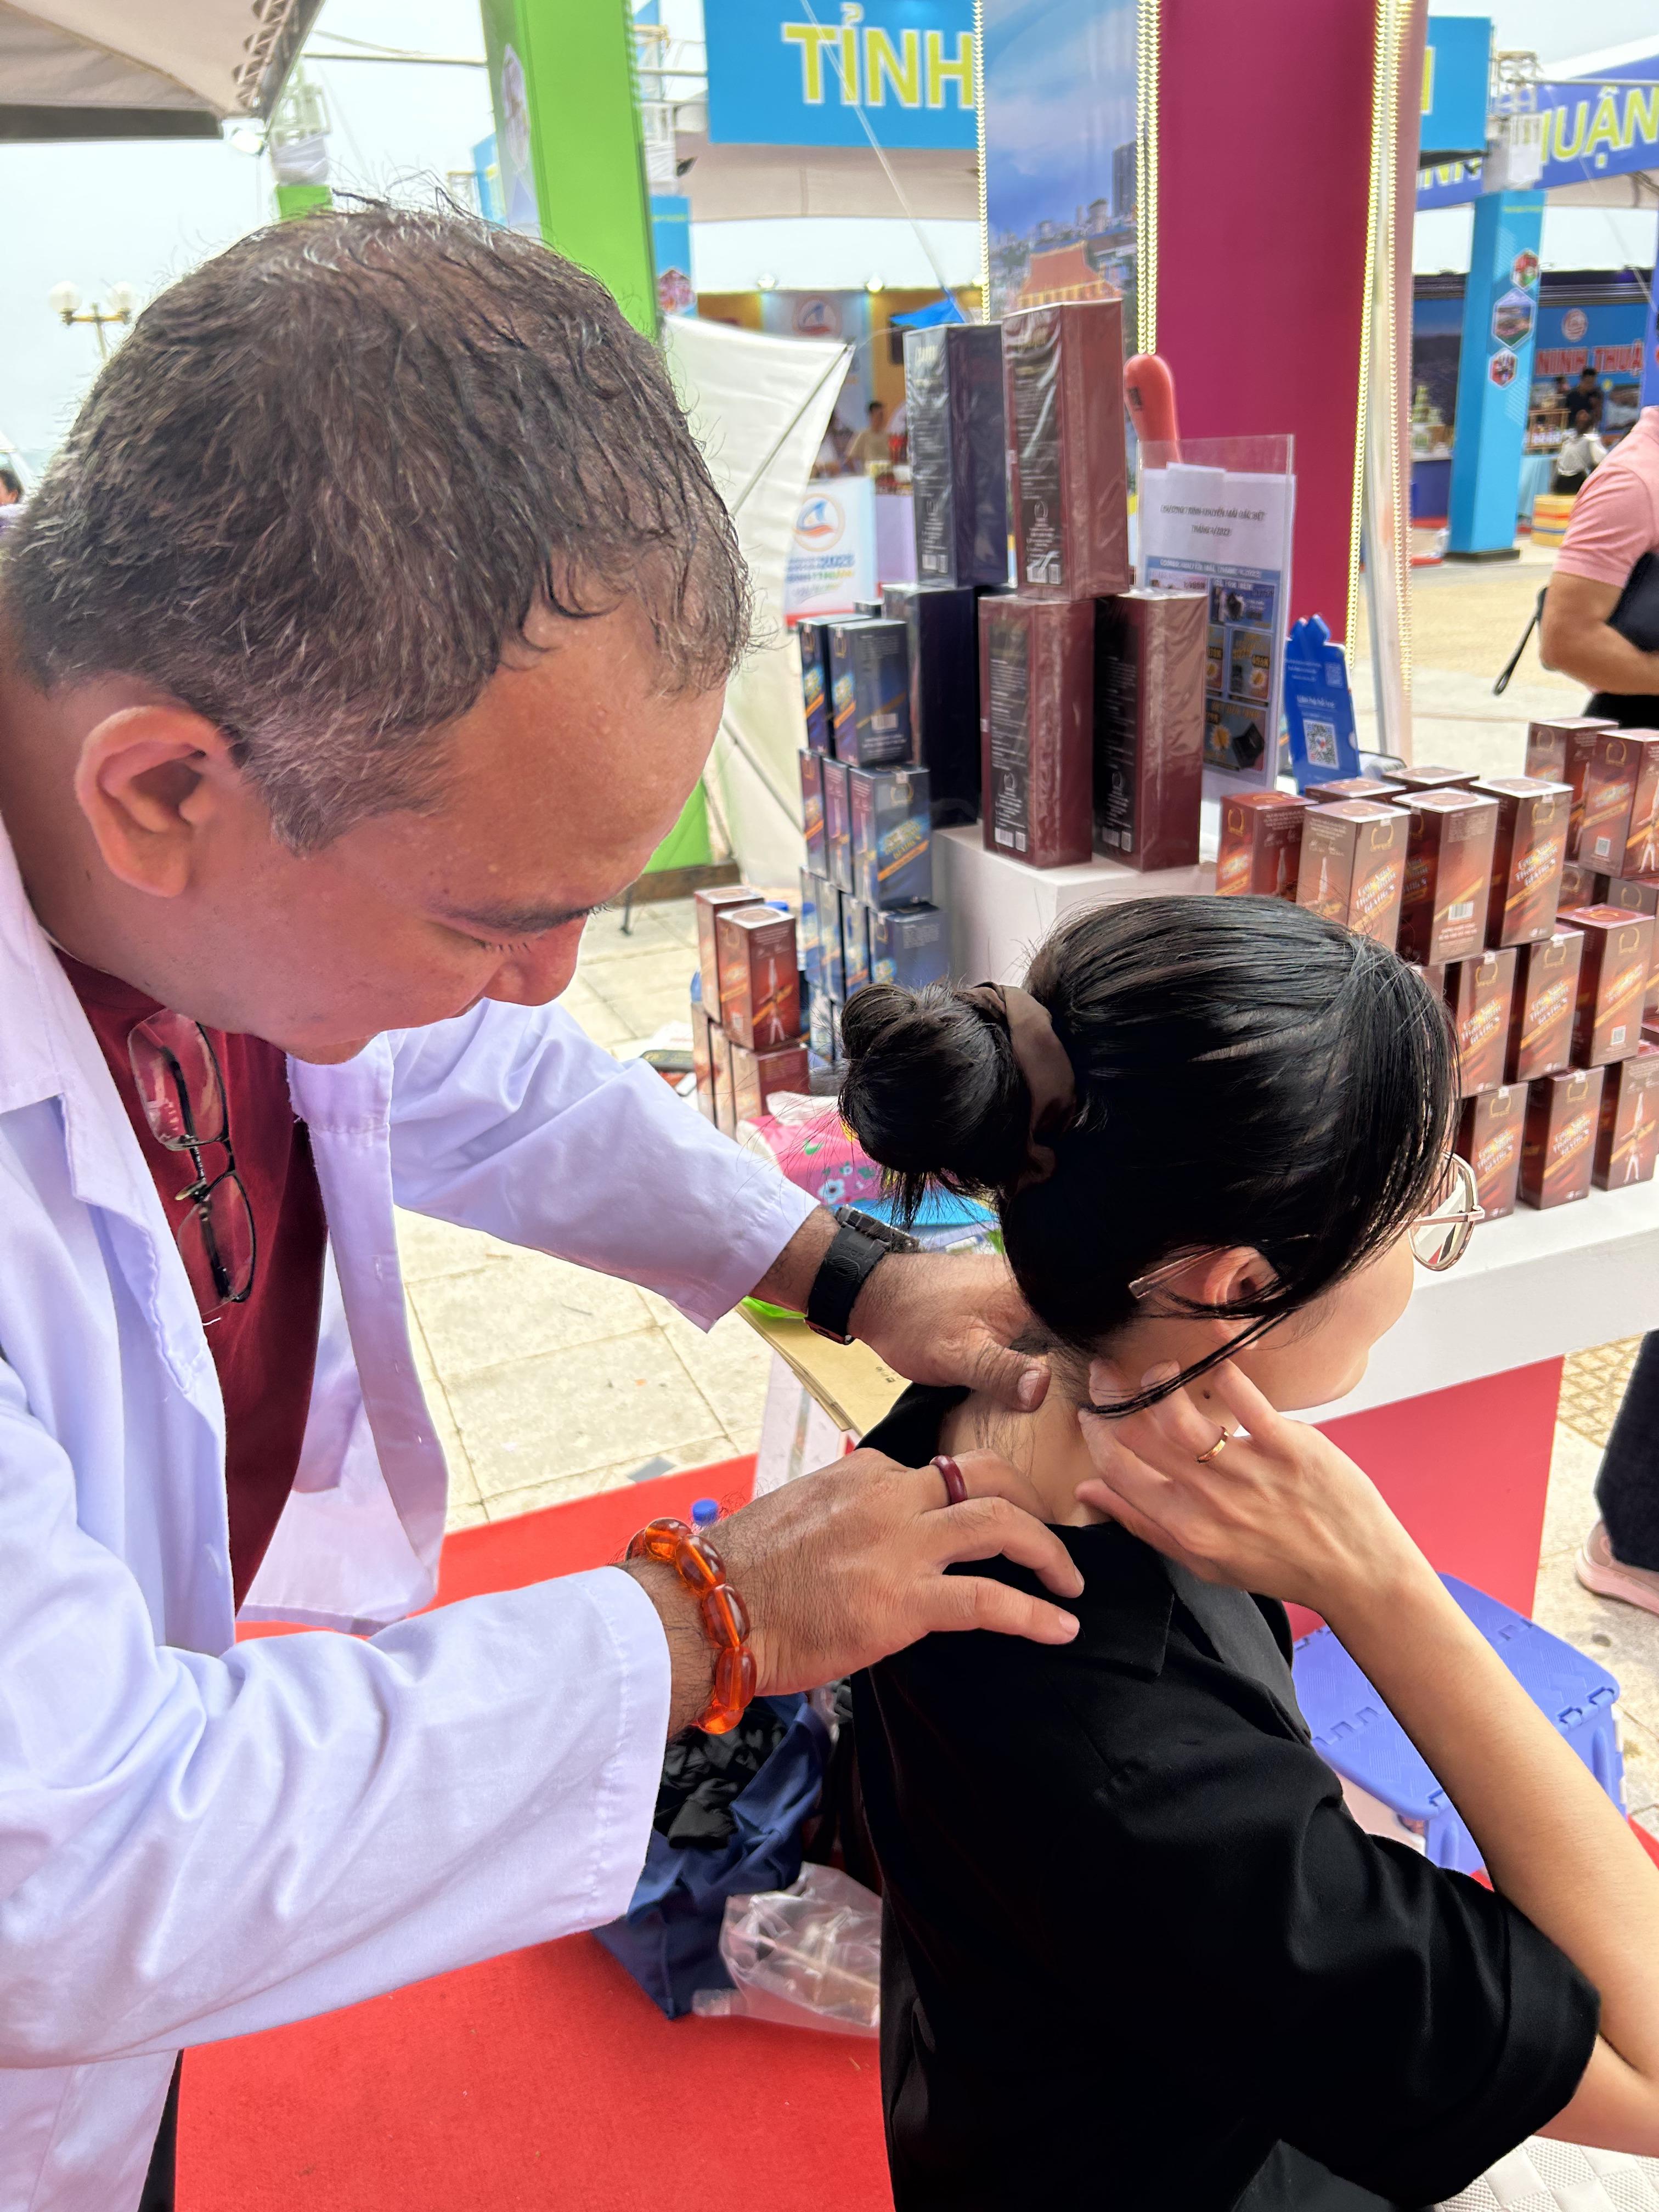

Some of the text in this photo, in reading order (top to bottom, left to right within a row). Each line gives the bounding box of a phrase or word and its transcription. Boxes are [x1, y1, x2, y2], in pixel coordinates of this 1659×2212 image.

[781, 2, 976, 109] TỈNH
[1539, 85, 1659, 169] UẬN
[1534, 346, 1587, 377] NINH
